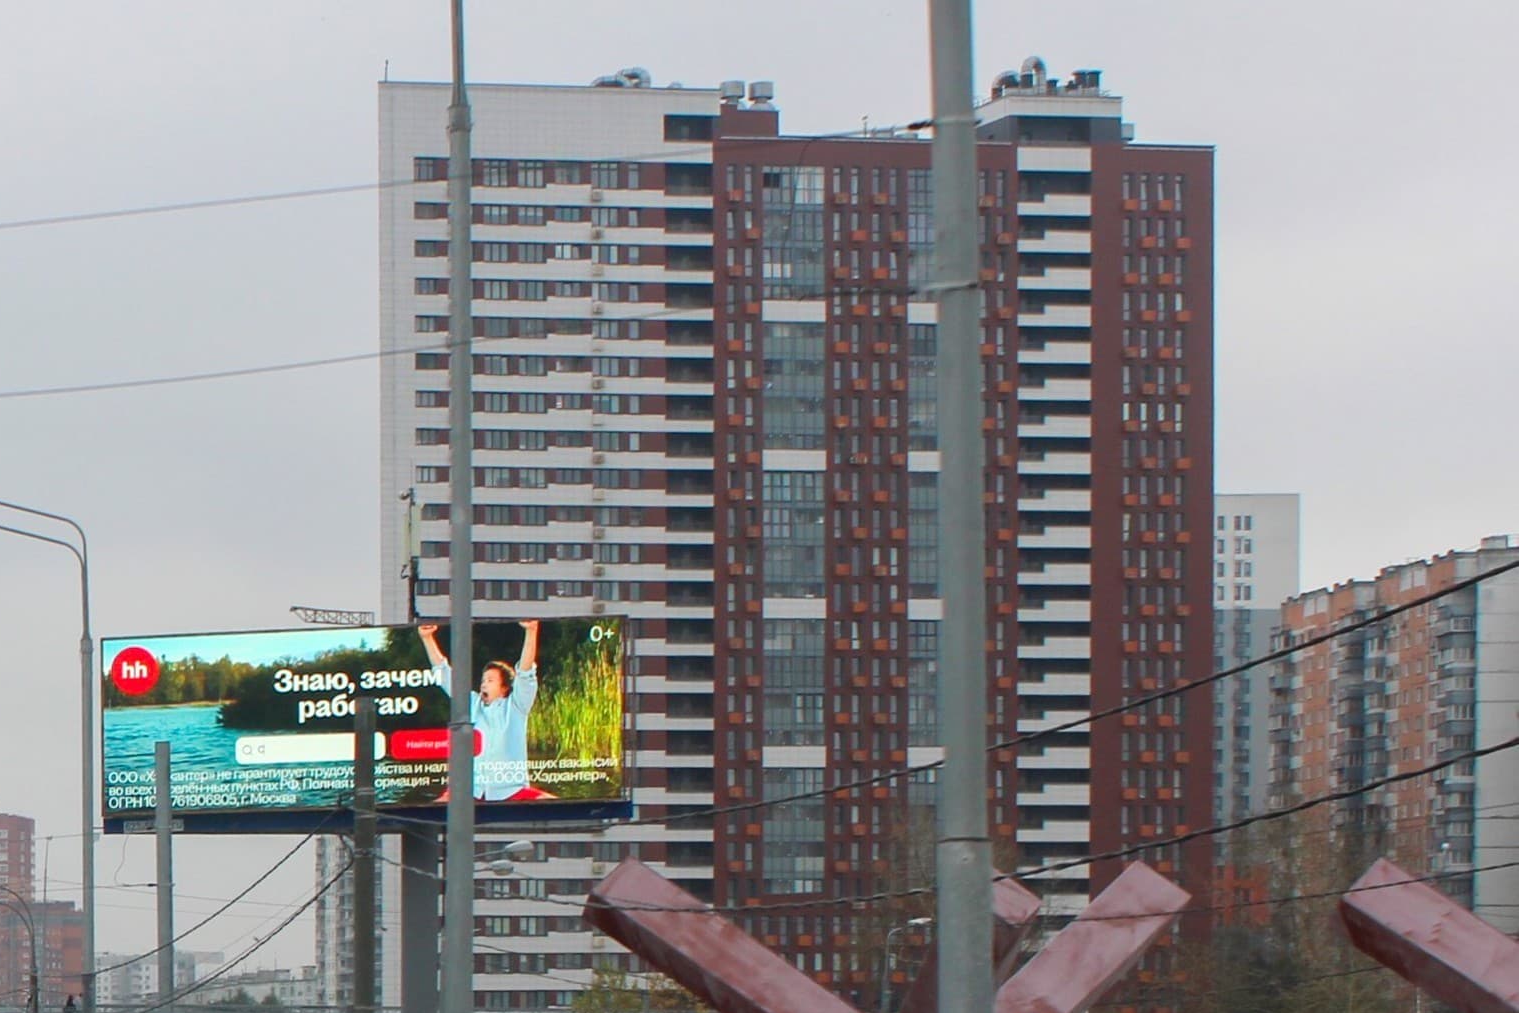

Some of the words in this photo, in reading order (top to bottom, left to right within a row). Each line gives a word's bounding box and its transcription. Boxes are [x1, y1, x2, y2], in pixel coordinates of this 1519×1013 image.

[590, 626, 615, 642] 0+
[121, 661, 147, 679] hh
[274, 670, 355, 694] Знаю,
[360, 669, 442, 688] зачем
[298, 694, 418, 723] рабаю
[109, 771, 138, 783] ООО
[217, 771, 232, 781] не
[234, 768, 308, 782] гарантирует
[414, 763, 423, 773] и
[479, 759, 557, 772] подходящих
[559, 756, 618, 769] вакансий
[109, 786, 123, 796] во
[125, 785, 152, 796] всех
[232, 782, 278, 793] пунктах
[302, 777, 348, 790] Полная
[495, 771, 525, 784] ООО
[527, 769, 609, 783] «Хэдхантер»,
[109, 796, 142, 809] ОГРН
[249, 794, 297, 805] Москва
